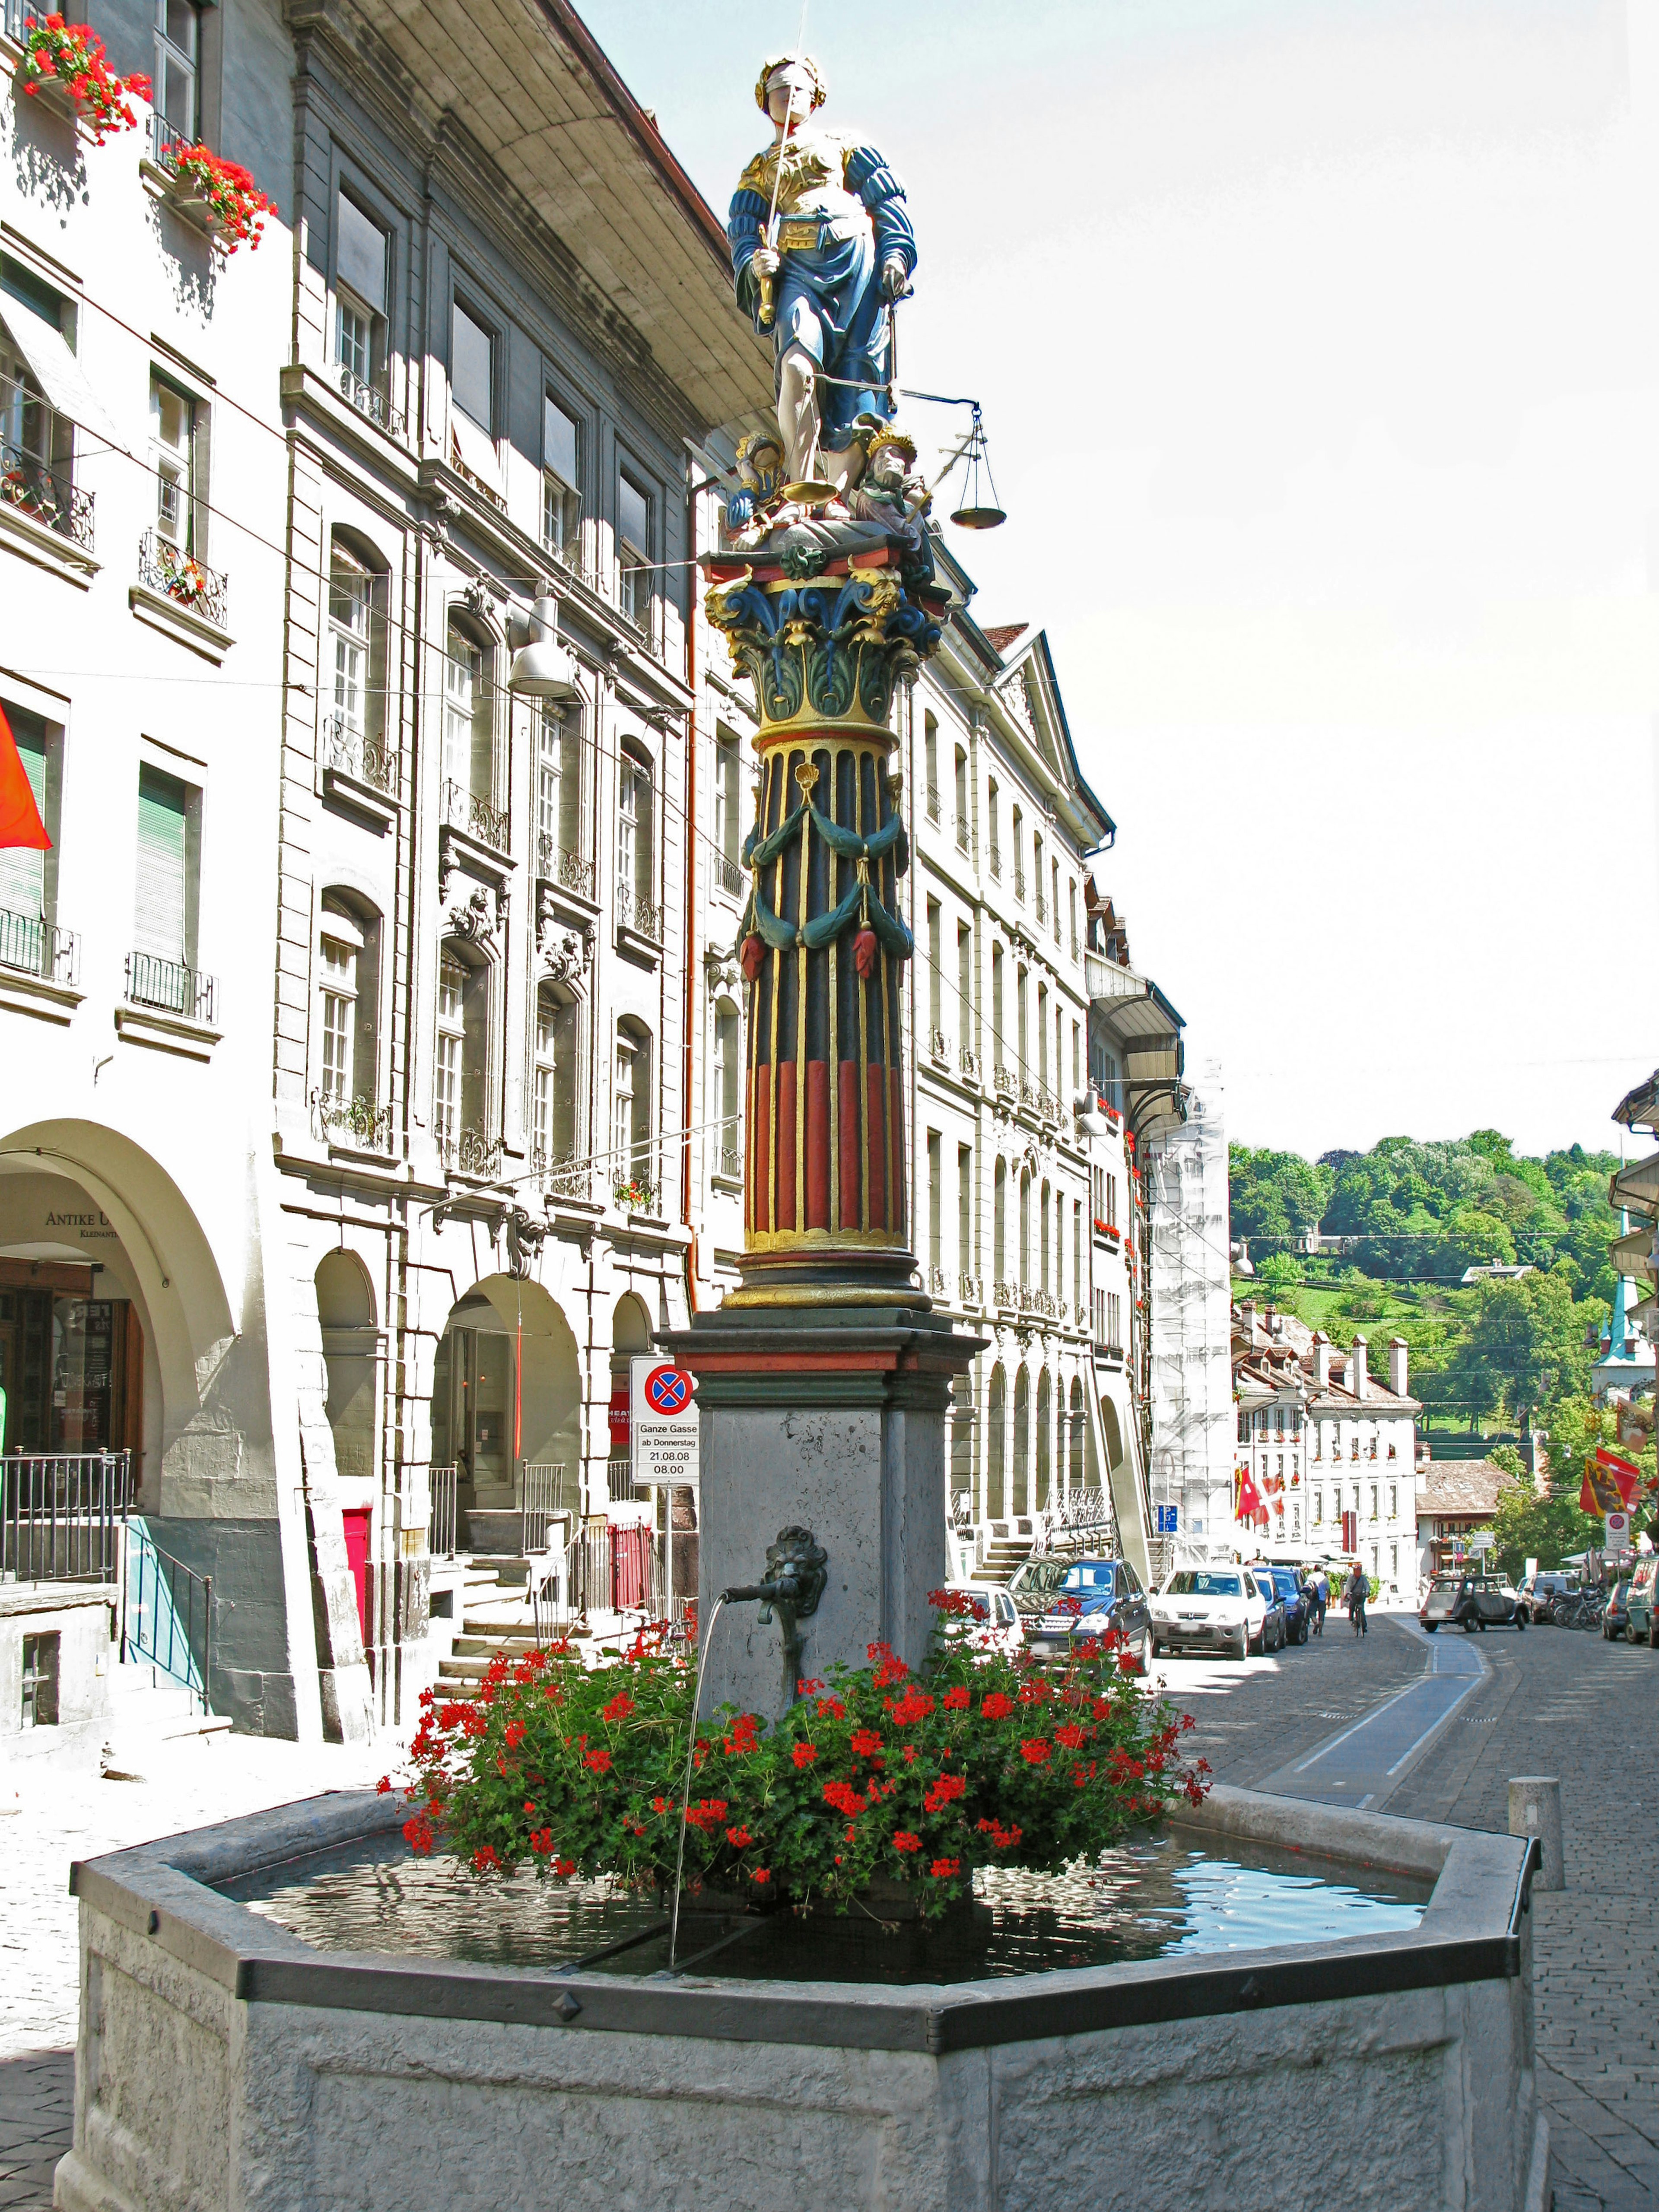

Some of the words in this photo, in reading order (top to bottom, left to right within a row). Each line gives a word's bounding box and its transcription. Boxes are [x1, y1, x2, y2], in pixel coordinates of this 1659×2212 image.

[100, 1211, 112, 1226] U
[640, 1425, 667, 1433] Ganze
[670, 1425, 697, 1433] Gasse
[654, 1439, 696, 1447] Donnerstag
[650, 1452, 690, 1461] 21.08.08
[654, 1466, 684, 1474] 08.00
